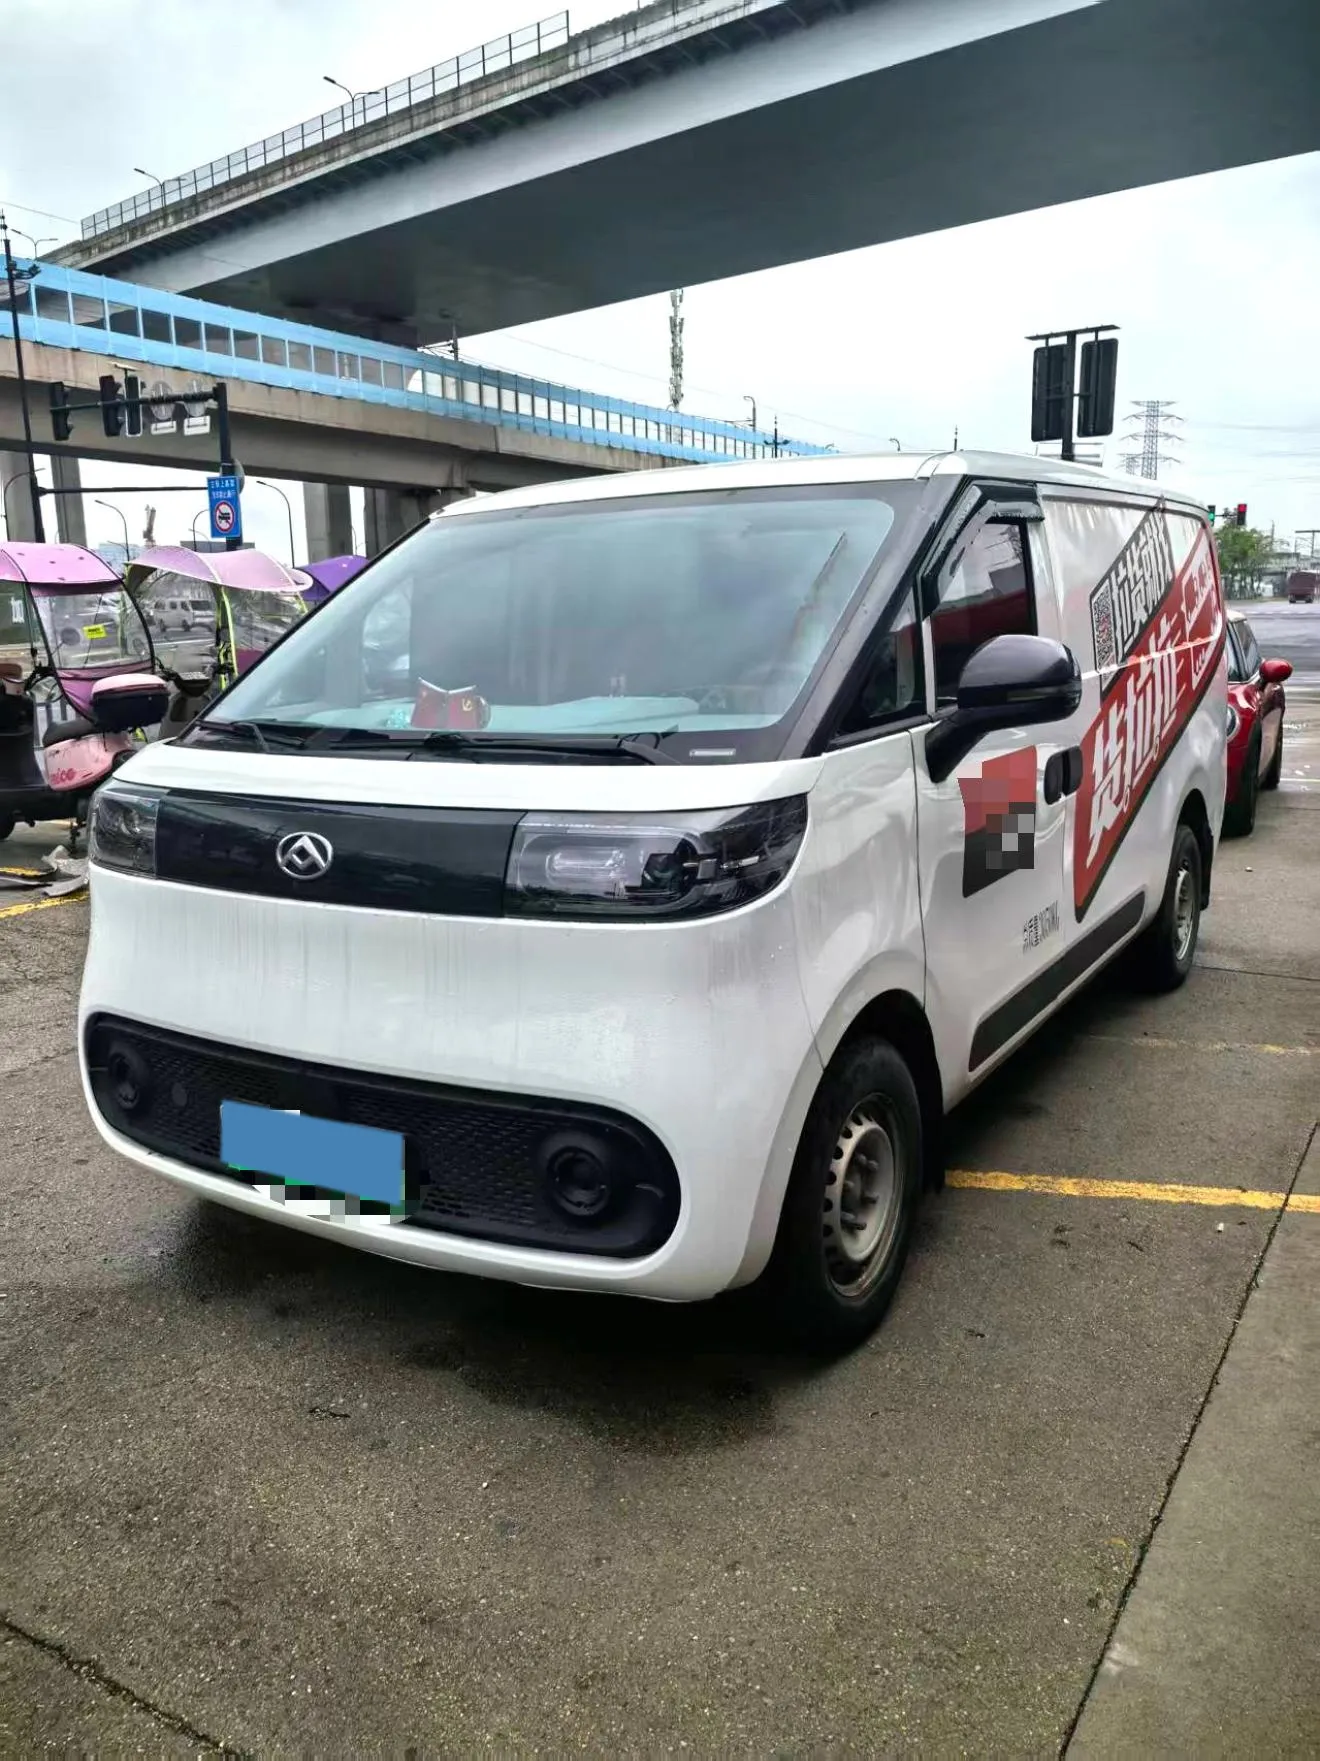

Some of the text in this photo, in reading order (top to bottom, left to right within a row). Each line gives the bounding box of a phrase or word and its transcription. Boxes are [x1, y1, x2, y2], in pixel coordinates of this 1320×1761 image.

[1110, 511, 1172, 663] 拉货就找
[1086, 613, 1181, 869] 货拉拉
